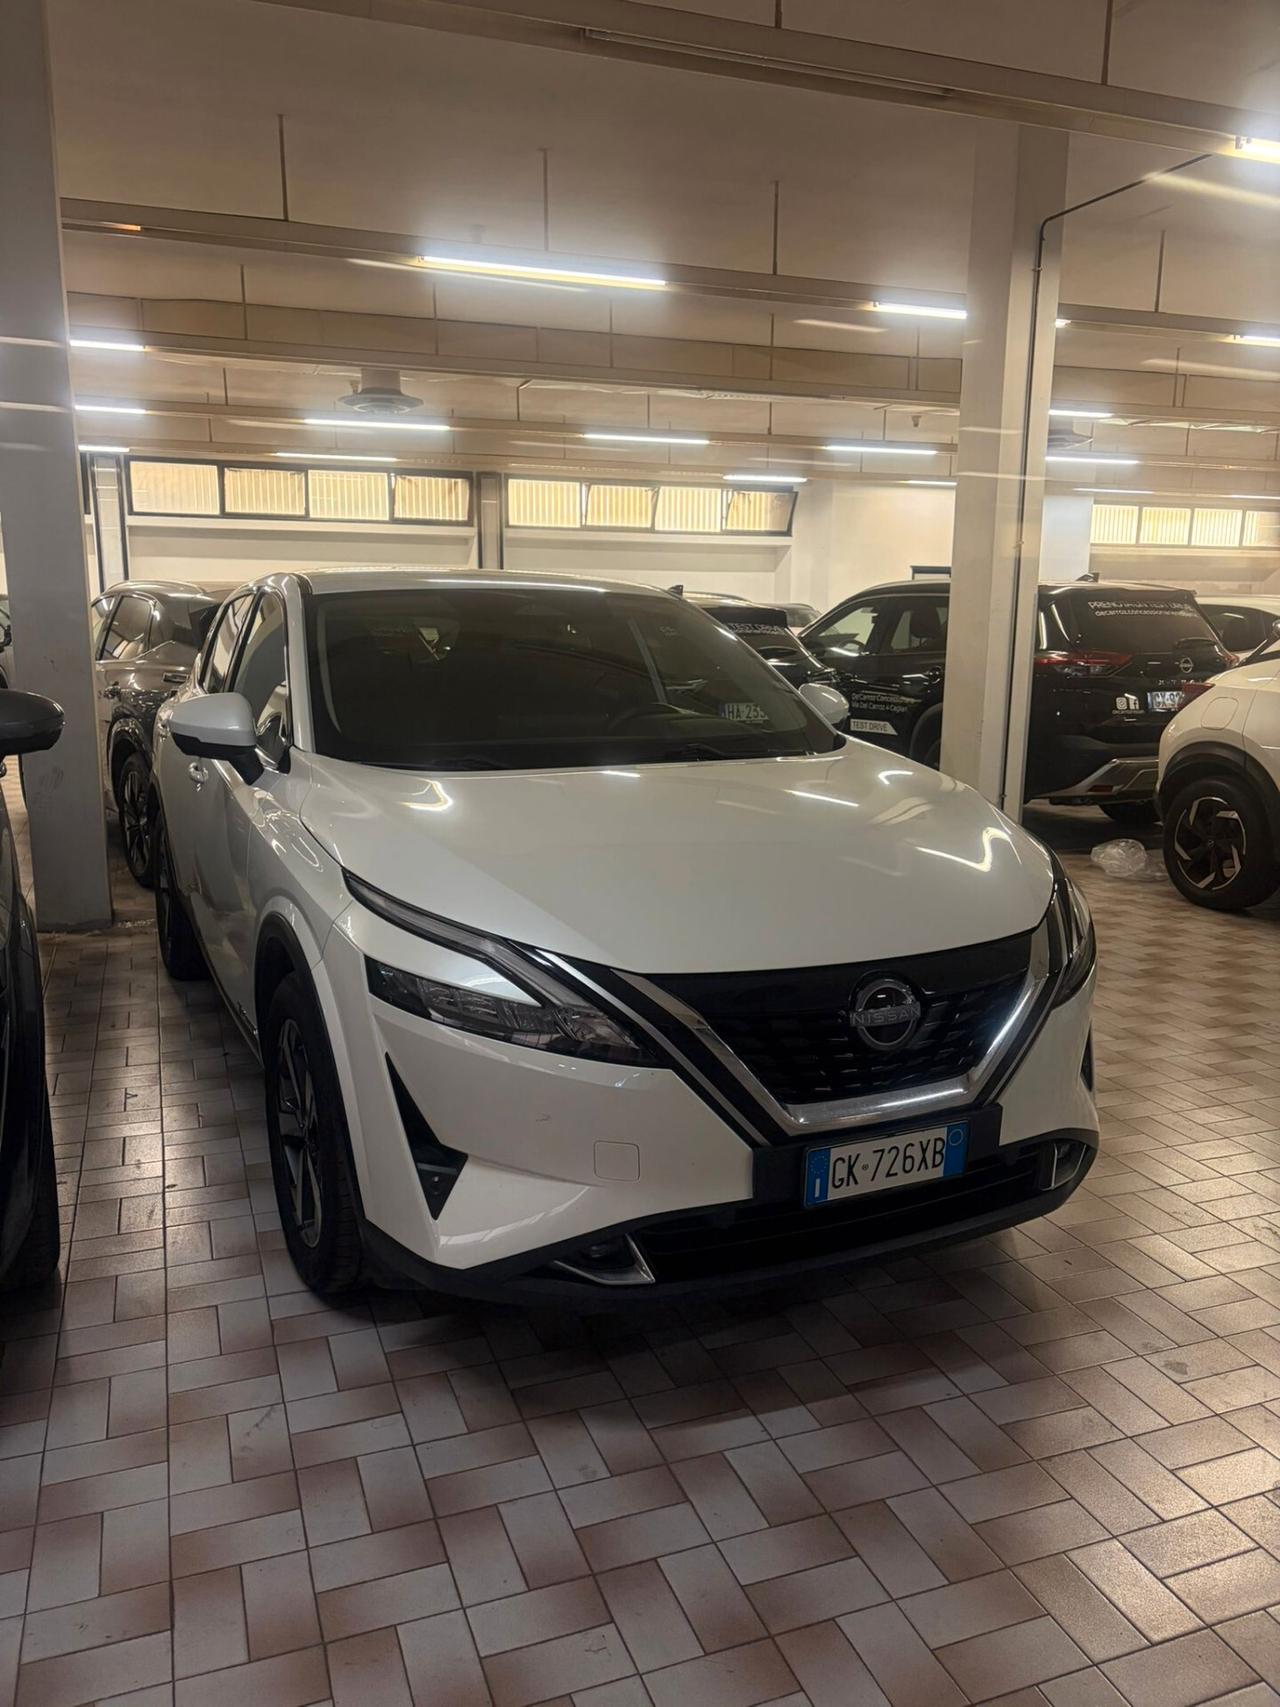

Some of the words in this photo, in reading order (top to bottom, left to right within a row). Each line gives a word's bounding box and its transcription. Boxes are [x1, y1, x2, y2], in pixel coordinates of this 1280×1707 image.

[852, 721, 868, 731] TEST
[869, 722, 888, 732] DRIVE
[852, 1003, 920, 1025] NISSAN
